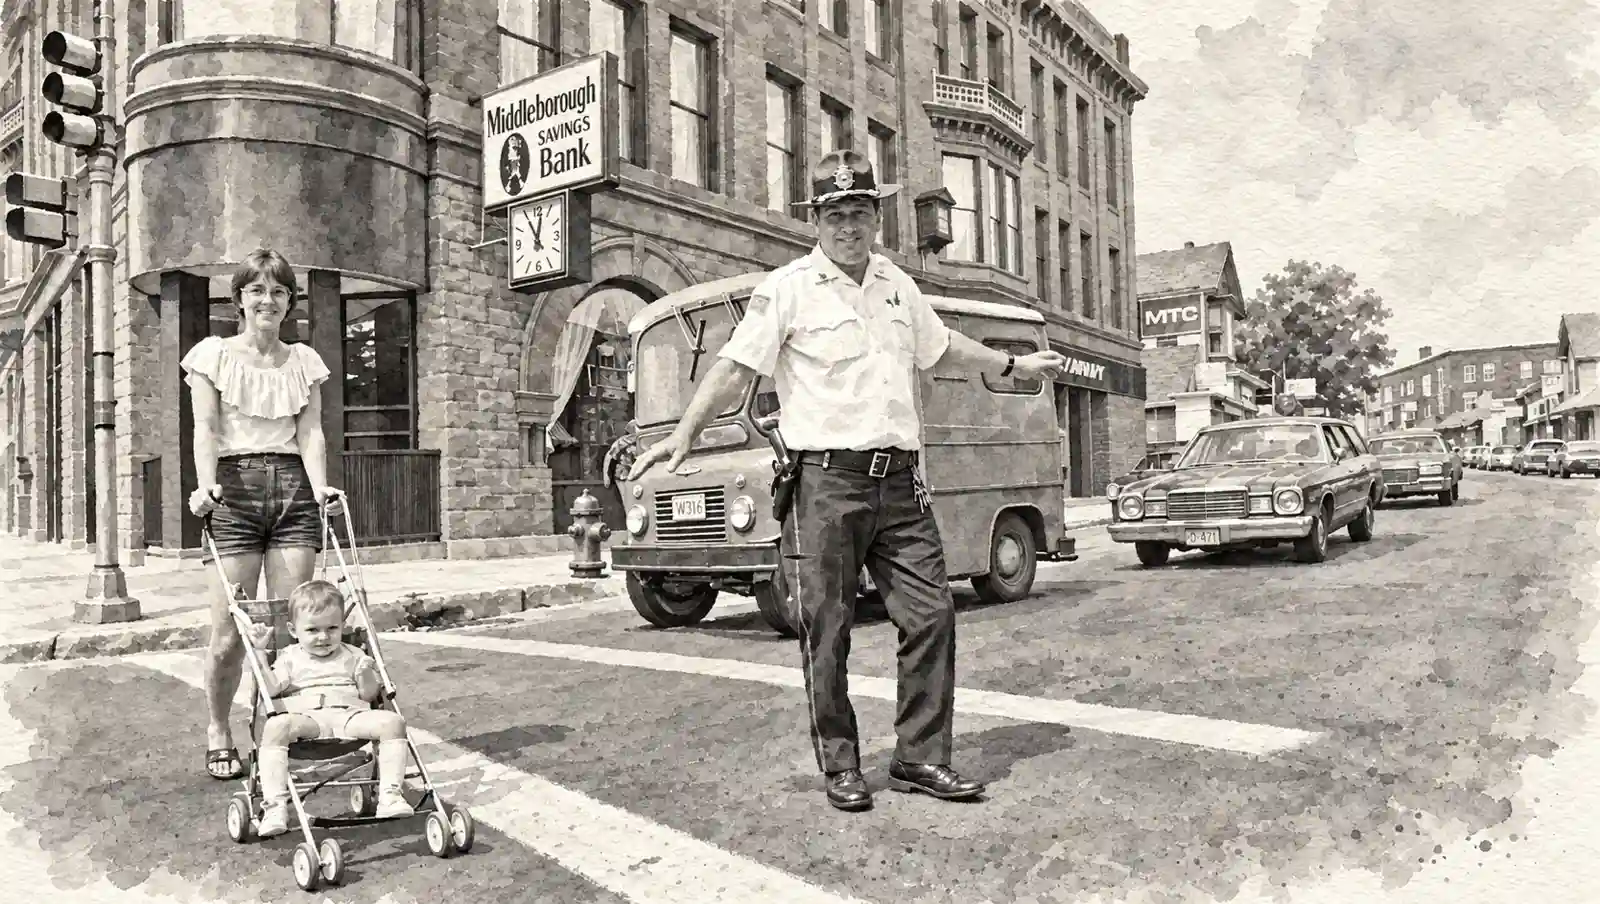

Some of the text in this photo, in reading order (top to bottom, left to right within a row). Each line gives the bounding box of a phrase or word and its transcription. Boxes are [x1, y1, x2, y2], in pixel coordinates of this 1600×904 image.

[487, 75, 596, 138] Middleborough
[538, 115, 591, 146] SAVINGS
[540, 137, 592, 179] Bank
[533, 205, 543, 217] 12
[553, 230, 560, 241] 3
[515, 239, 522, 250] 9
[535, 261, 542, 271] 6
[1145, 306, 1199, 326] MTC
